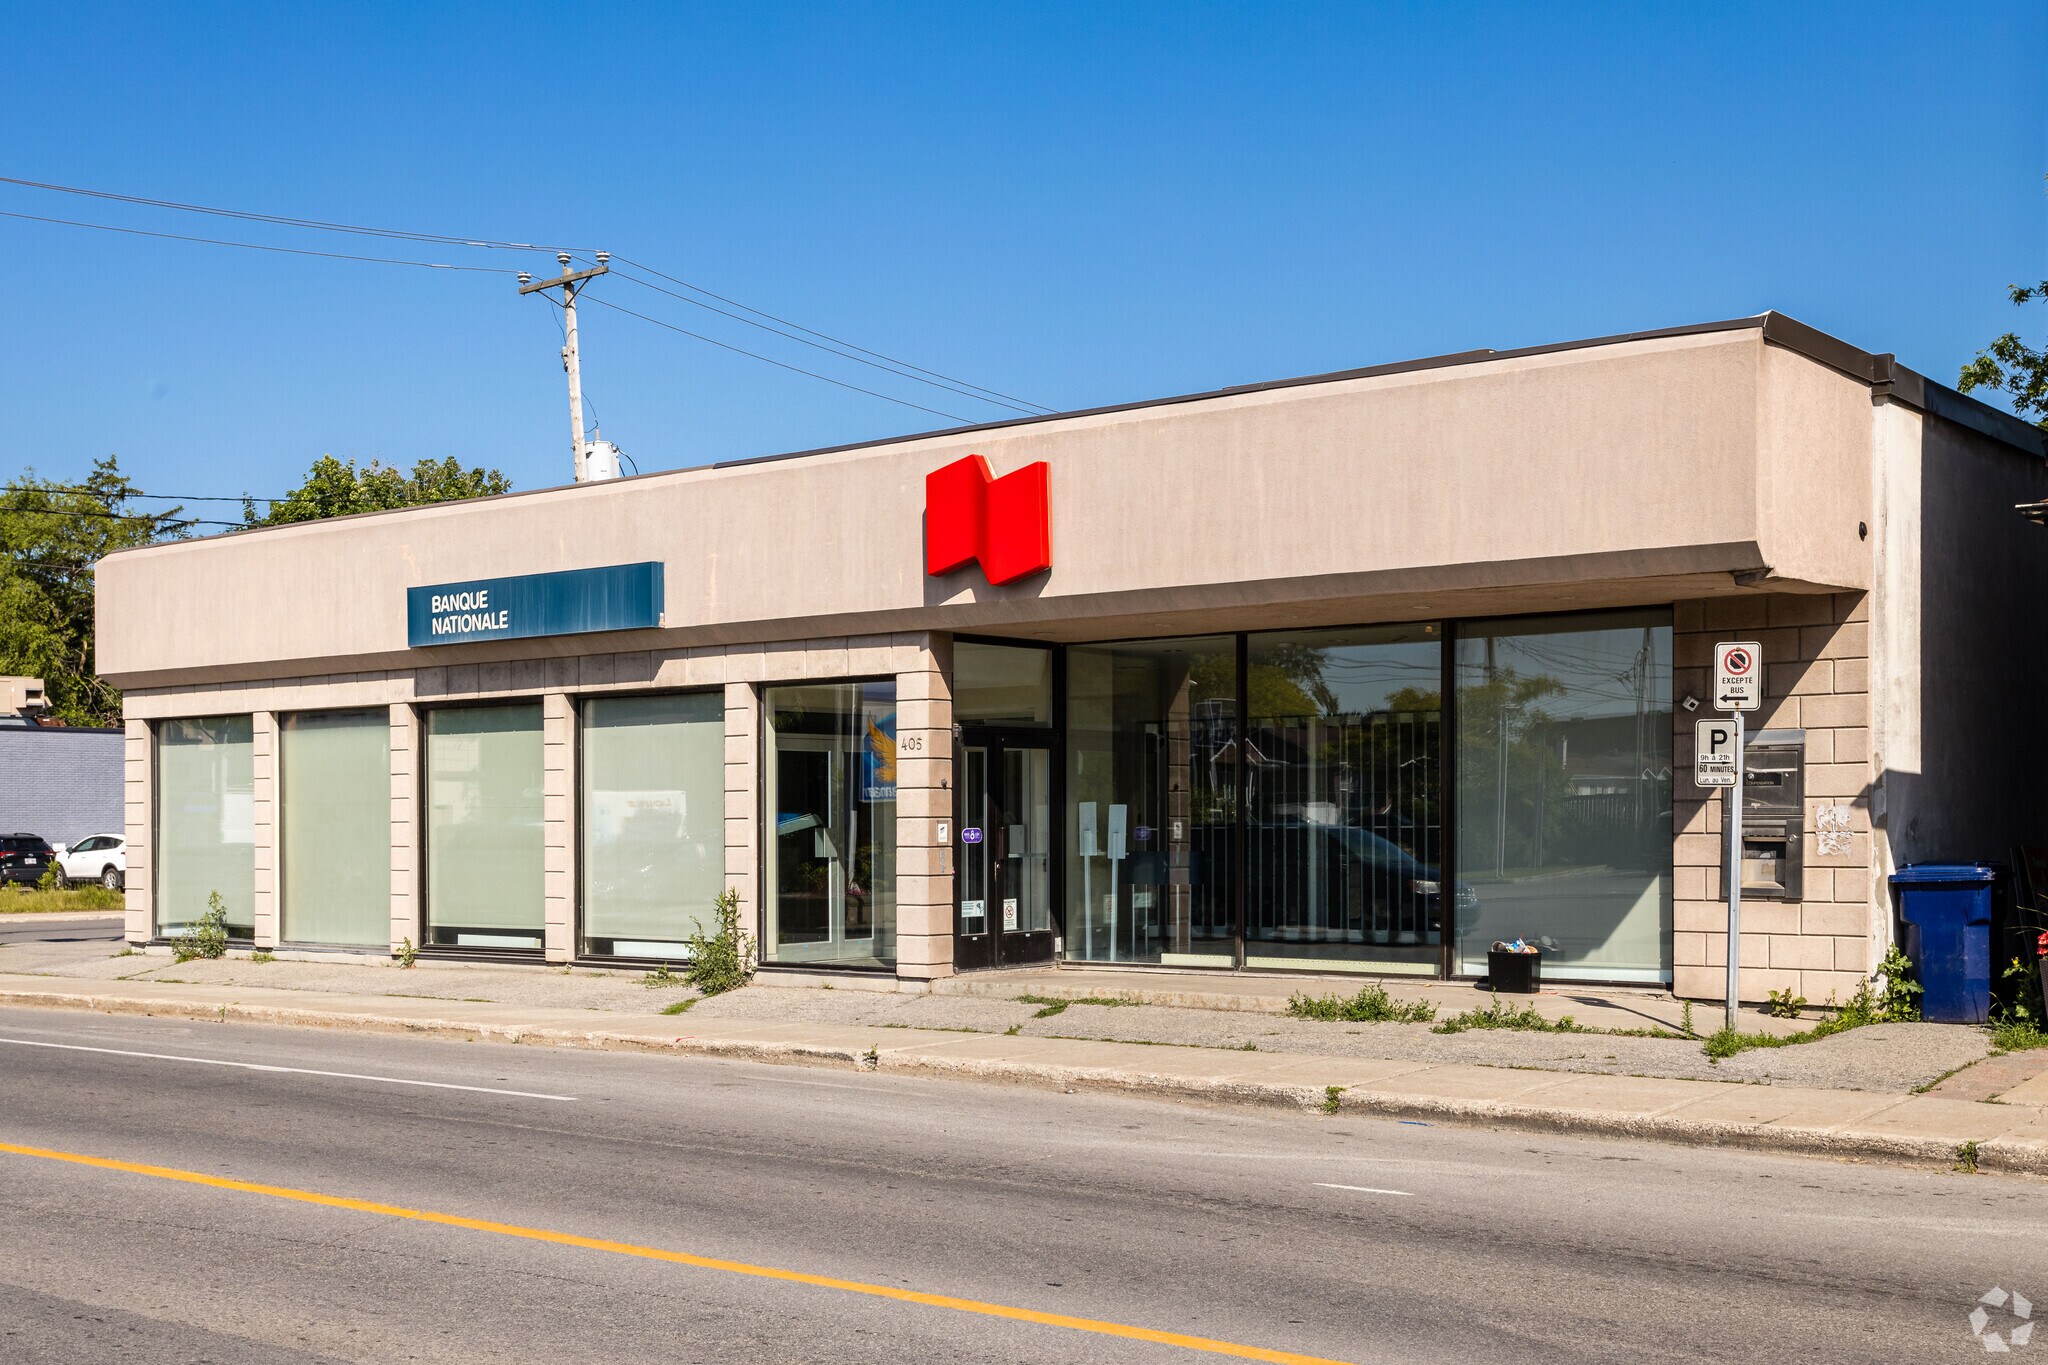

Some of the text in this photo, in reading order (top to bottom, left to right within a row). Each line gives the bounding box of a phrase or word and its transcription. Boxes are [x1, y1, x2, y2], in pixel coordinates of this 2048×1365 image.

[431, 589, 489, 614] BANQUE
[431, 609, 509, 635] NATIONALE
[1730, 686, 1745, 694] BUS
[901, 737, 922, 751] 405
[1711, 729, 1728, 754] P
[1699, 764, 1735, 773] 60 MINUTES
